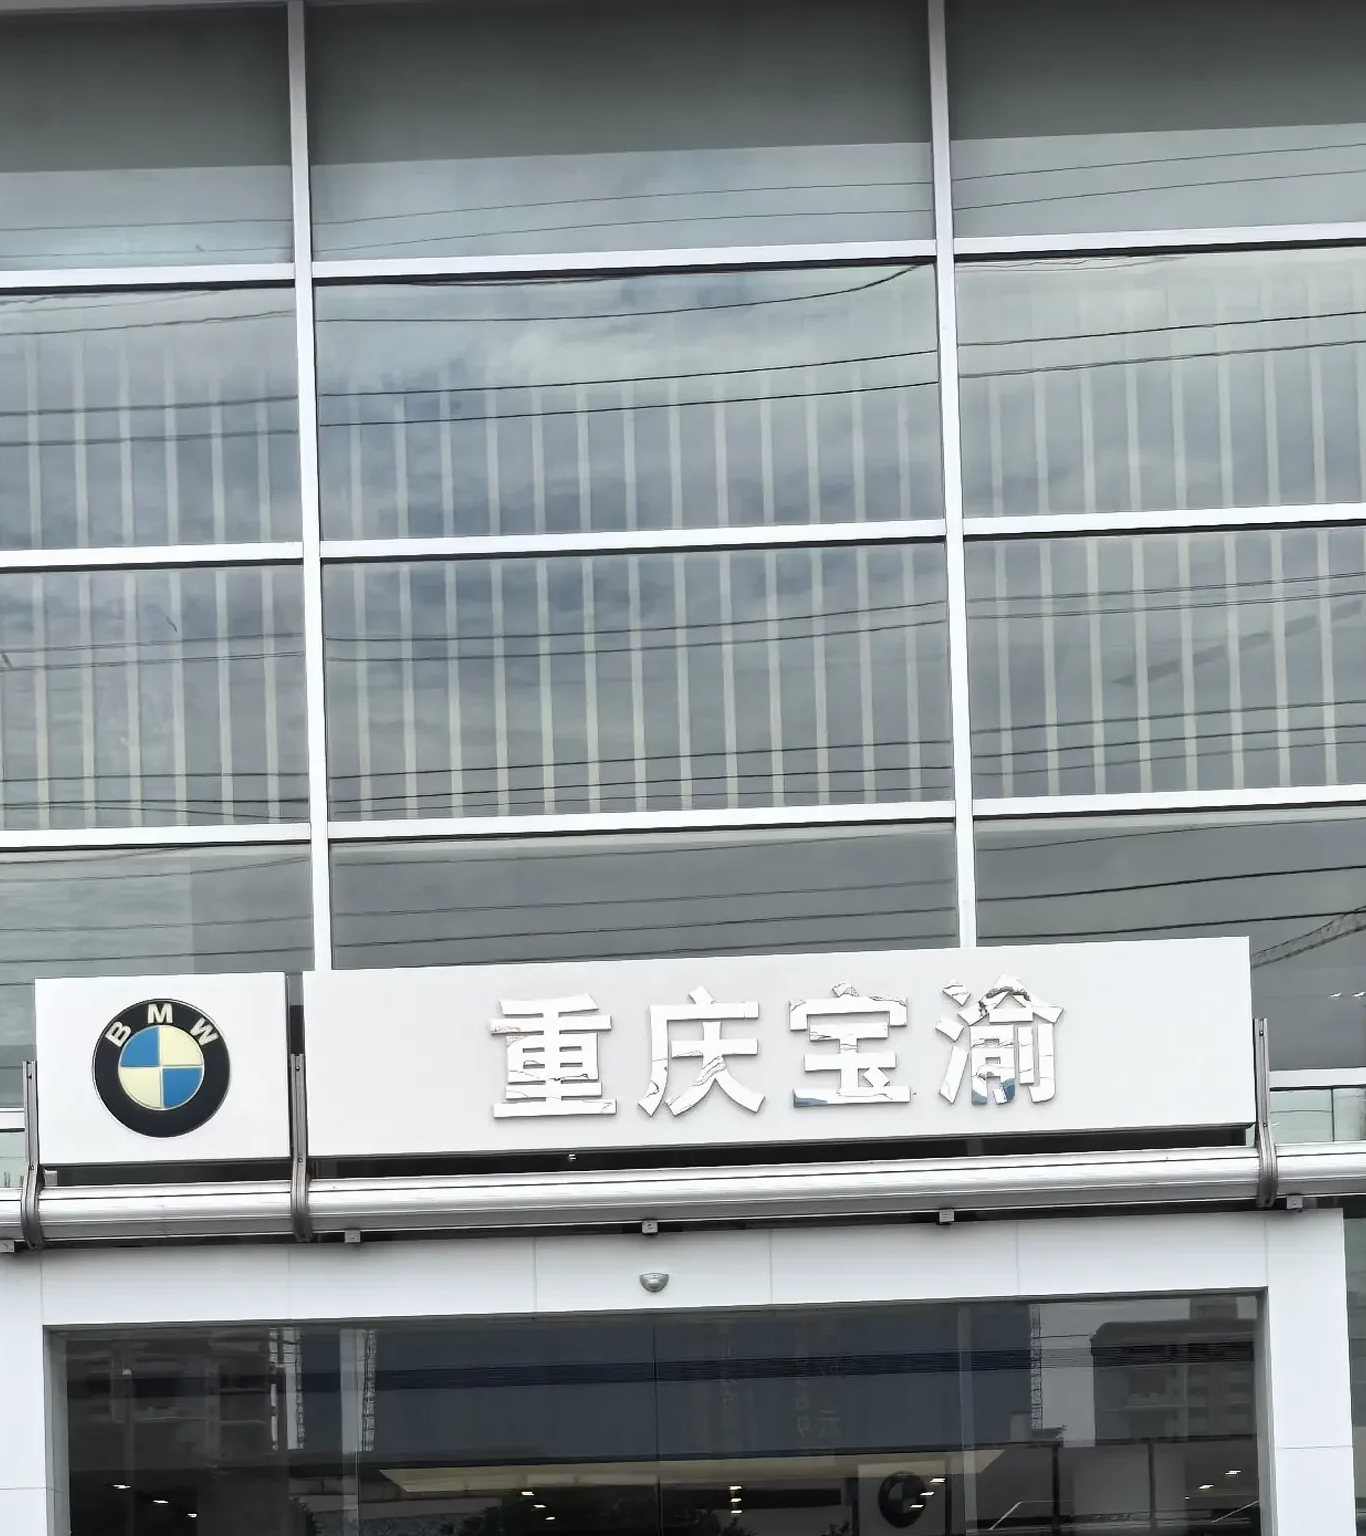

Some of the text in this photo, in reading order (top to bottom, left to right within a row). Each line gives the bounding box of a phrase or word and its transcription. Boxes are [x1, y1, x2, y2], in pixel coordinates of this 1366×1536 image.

[104, 1002, 220, 1048] BMW
[489, 973, 1065, 1119] 重庆宝渝
